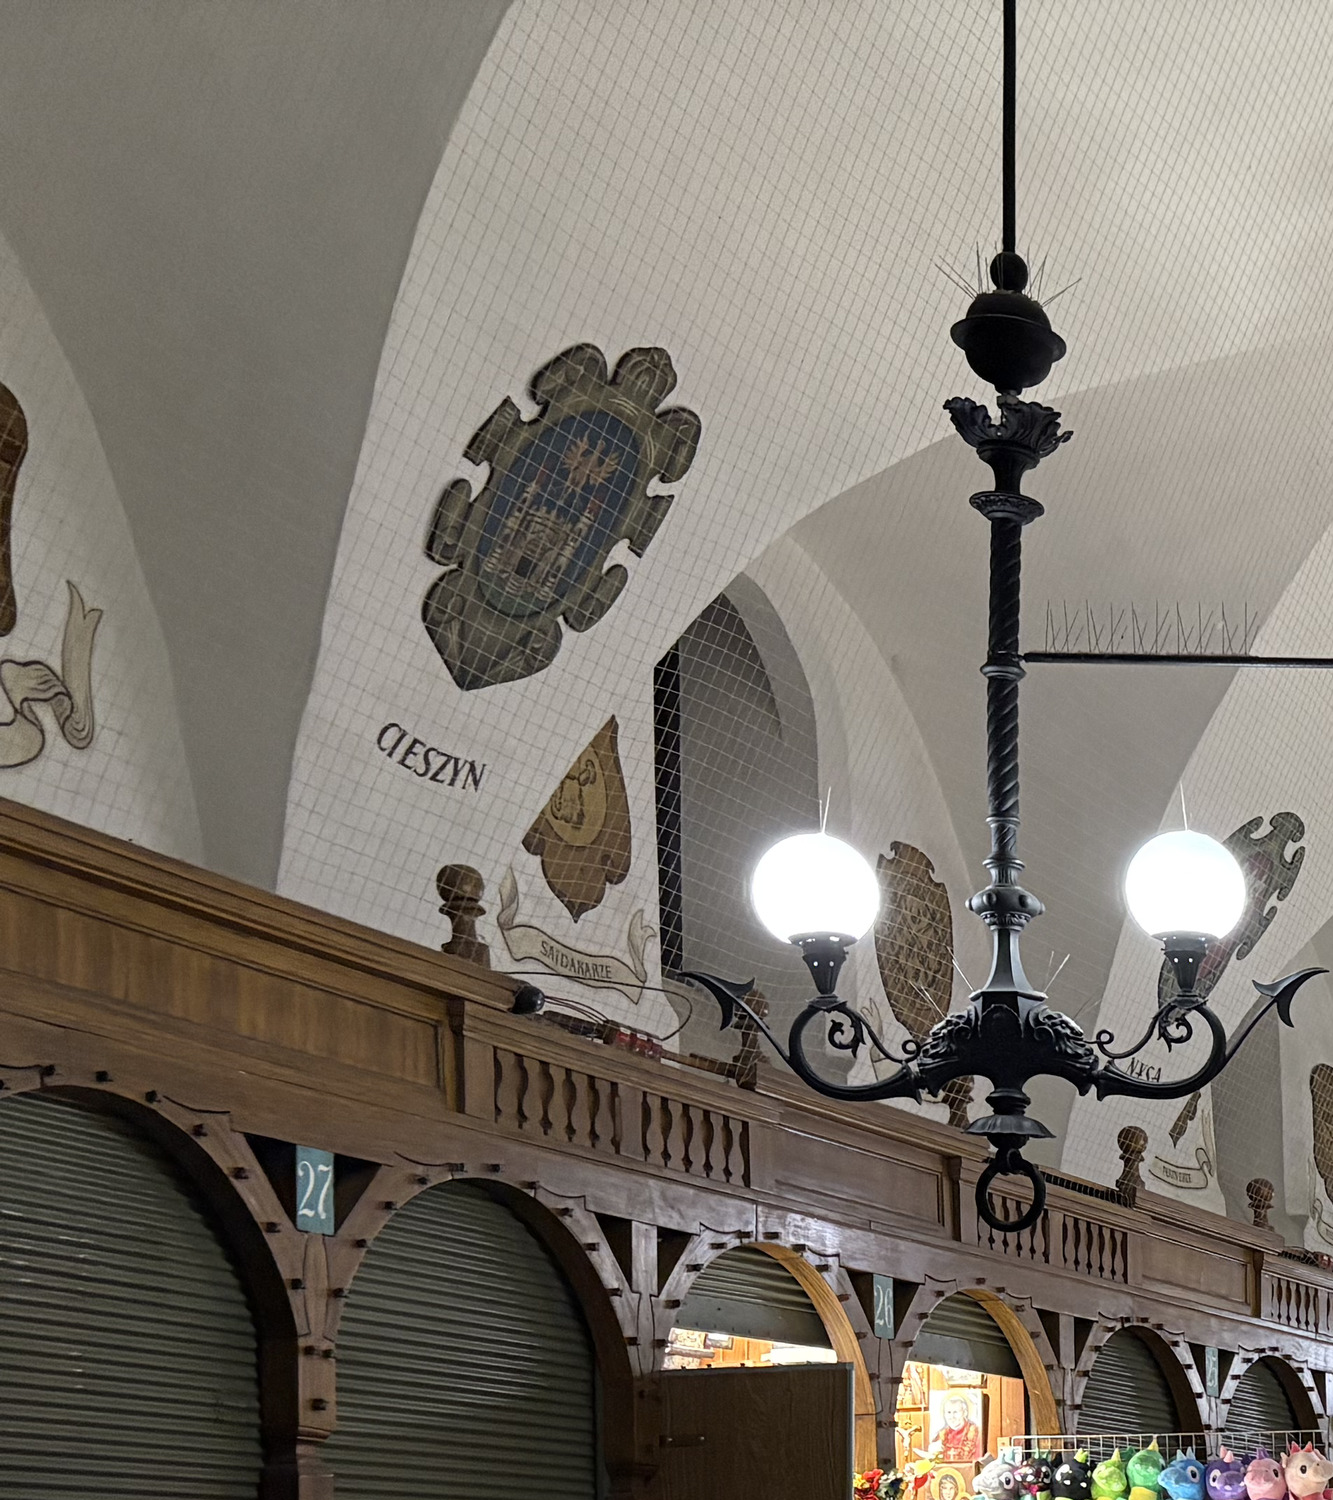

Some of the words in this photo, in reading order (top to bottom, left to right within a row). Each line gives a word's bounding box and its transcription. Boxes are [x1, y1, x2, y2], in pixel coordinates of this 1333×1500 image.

[377, 722, 486, 792] CIESZYN
[298, 1161, 333, 1219] 27
[873, 1285, 893, 1328] 26
